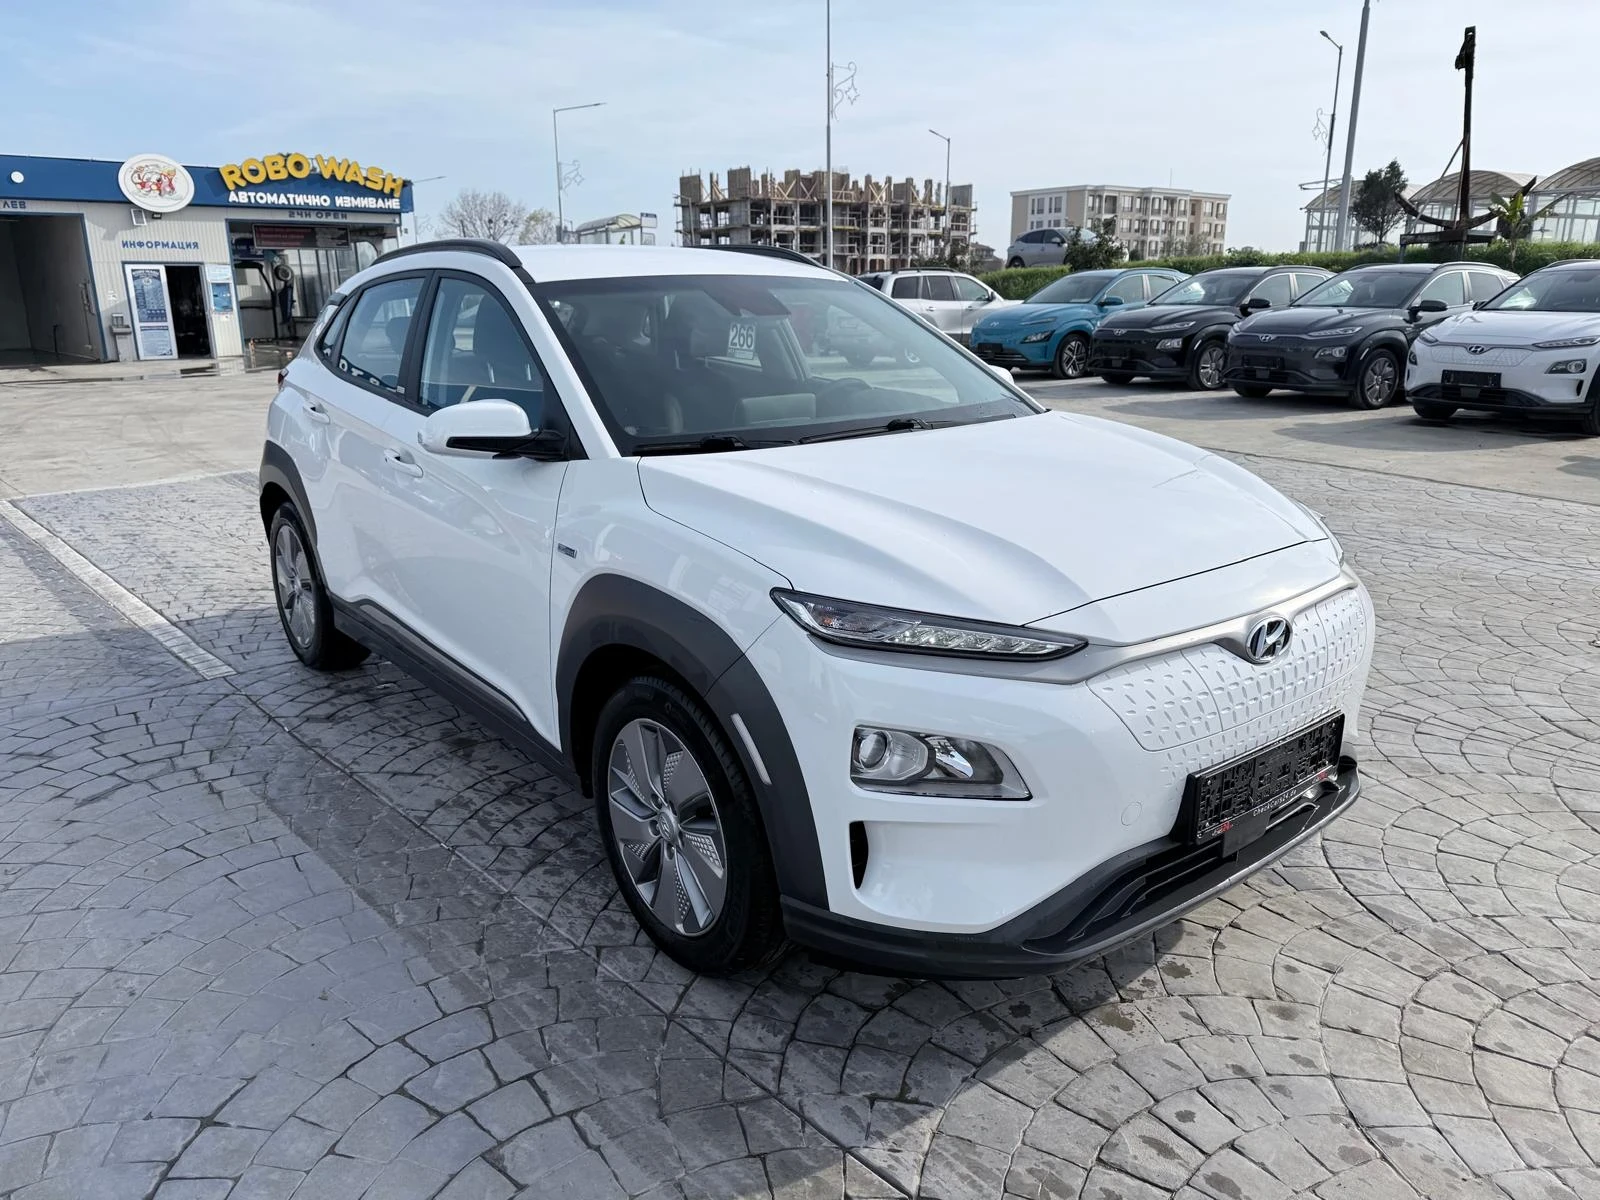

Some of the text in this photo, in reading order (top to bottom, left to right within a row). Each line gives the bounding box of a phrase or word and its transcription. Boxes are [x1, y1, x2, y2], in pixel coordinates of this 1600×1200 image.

[219, 153, 403, 197] ROBO WASH
[228, 191, 400, 209] АВТОМАТИЧНО ИЗМИВАНЕ
[316, 211, 348, 220] OPEN
[121, 240, 199, 250] ИНФОРМАЦИЯ
[730, 324, 754, 348] 266
